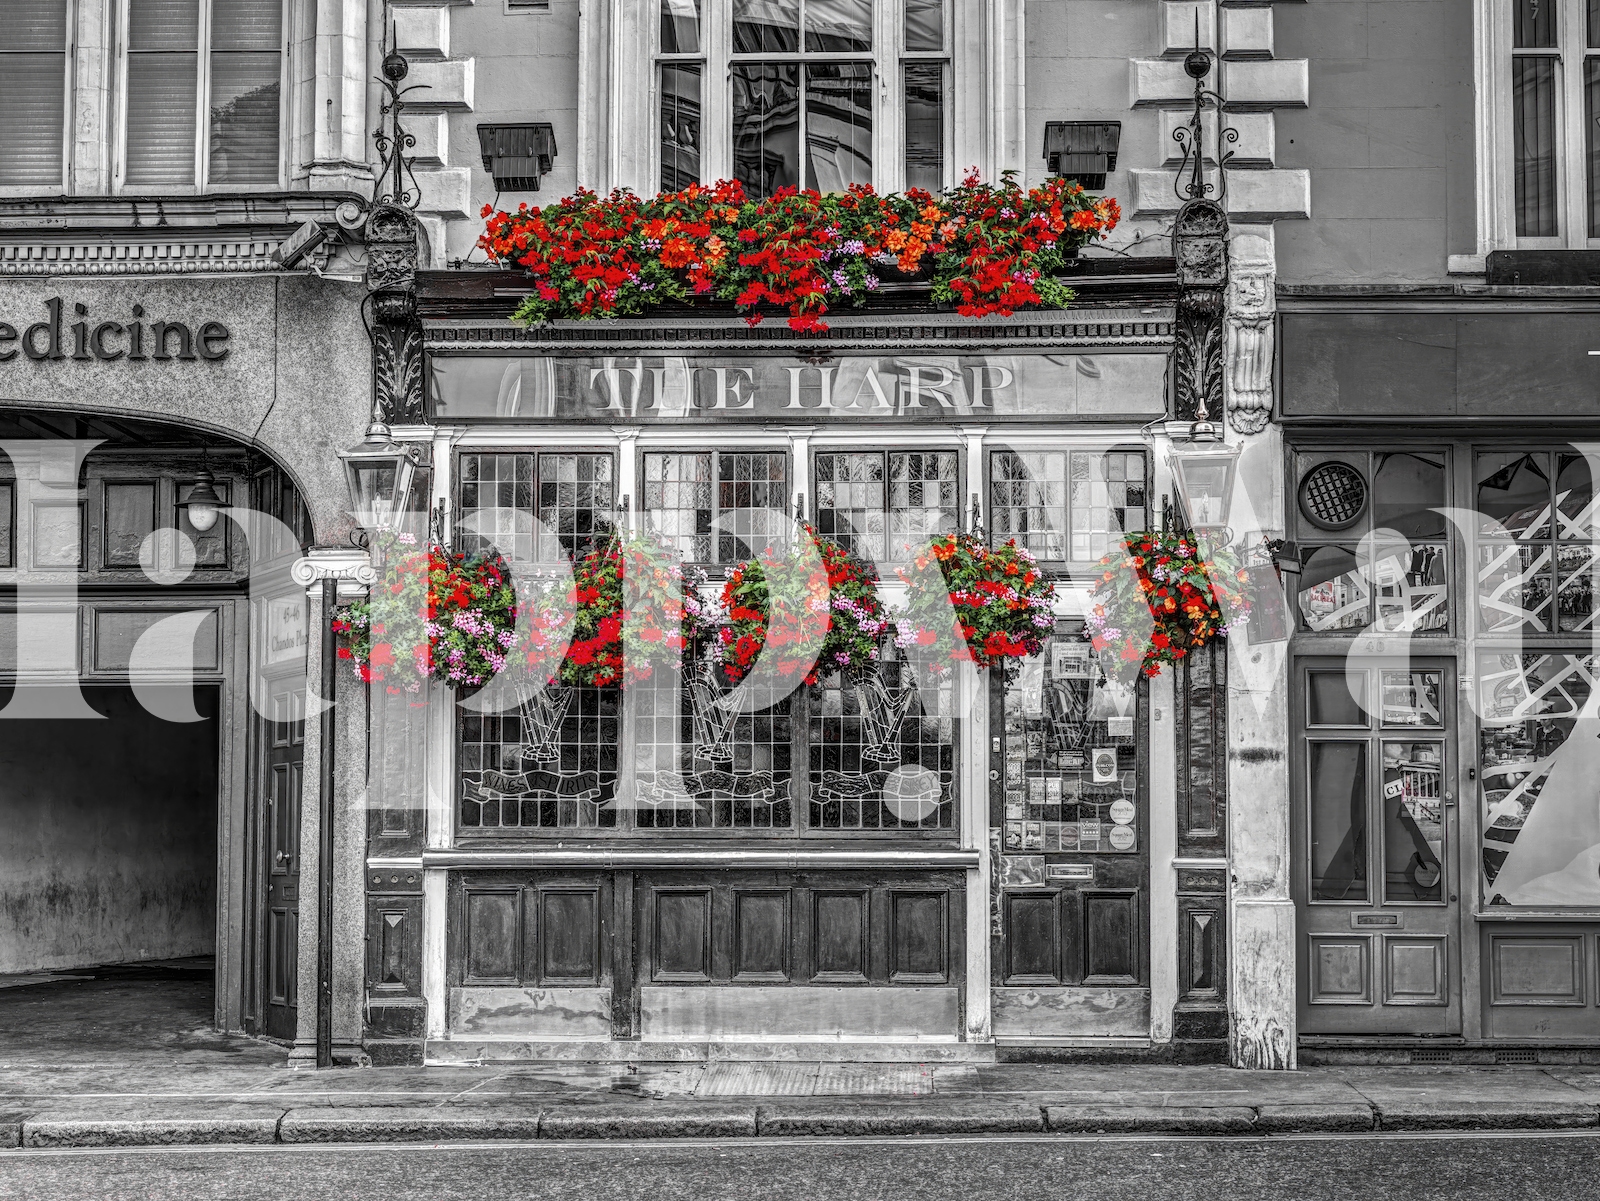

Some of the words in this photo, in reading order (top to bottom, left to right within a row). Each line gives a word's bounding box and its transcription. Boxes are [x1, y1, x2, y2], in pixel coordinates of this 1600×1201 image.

[590, 367, 755, 409] THE
[780, 366, 1014, 409] HARP
[484, 775, 526, 791] WINES
[539, 774, 597, 793] SPIRITS
